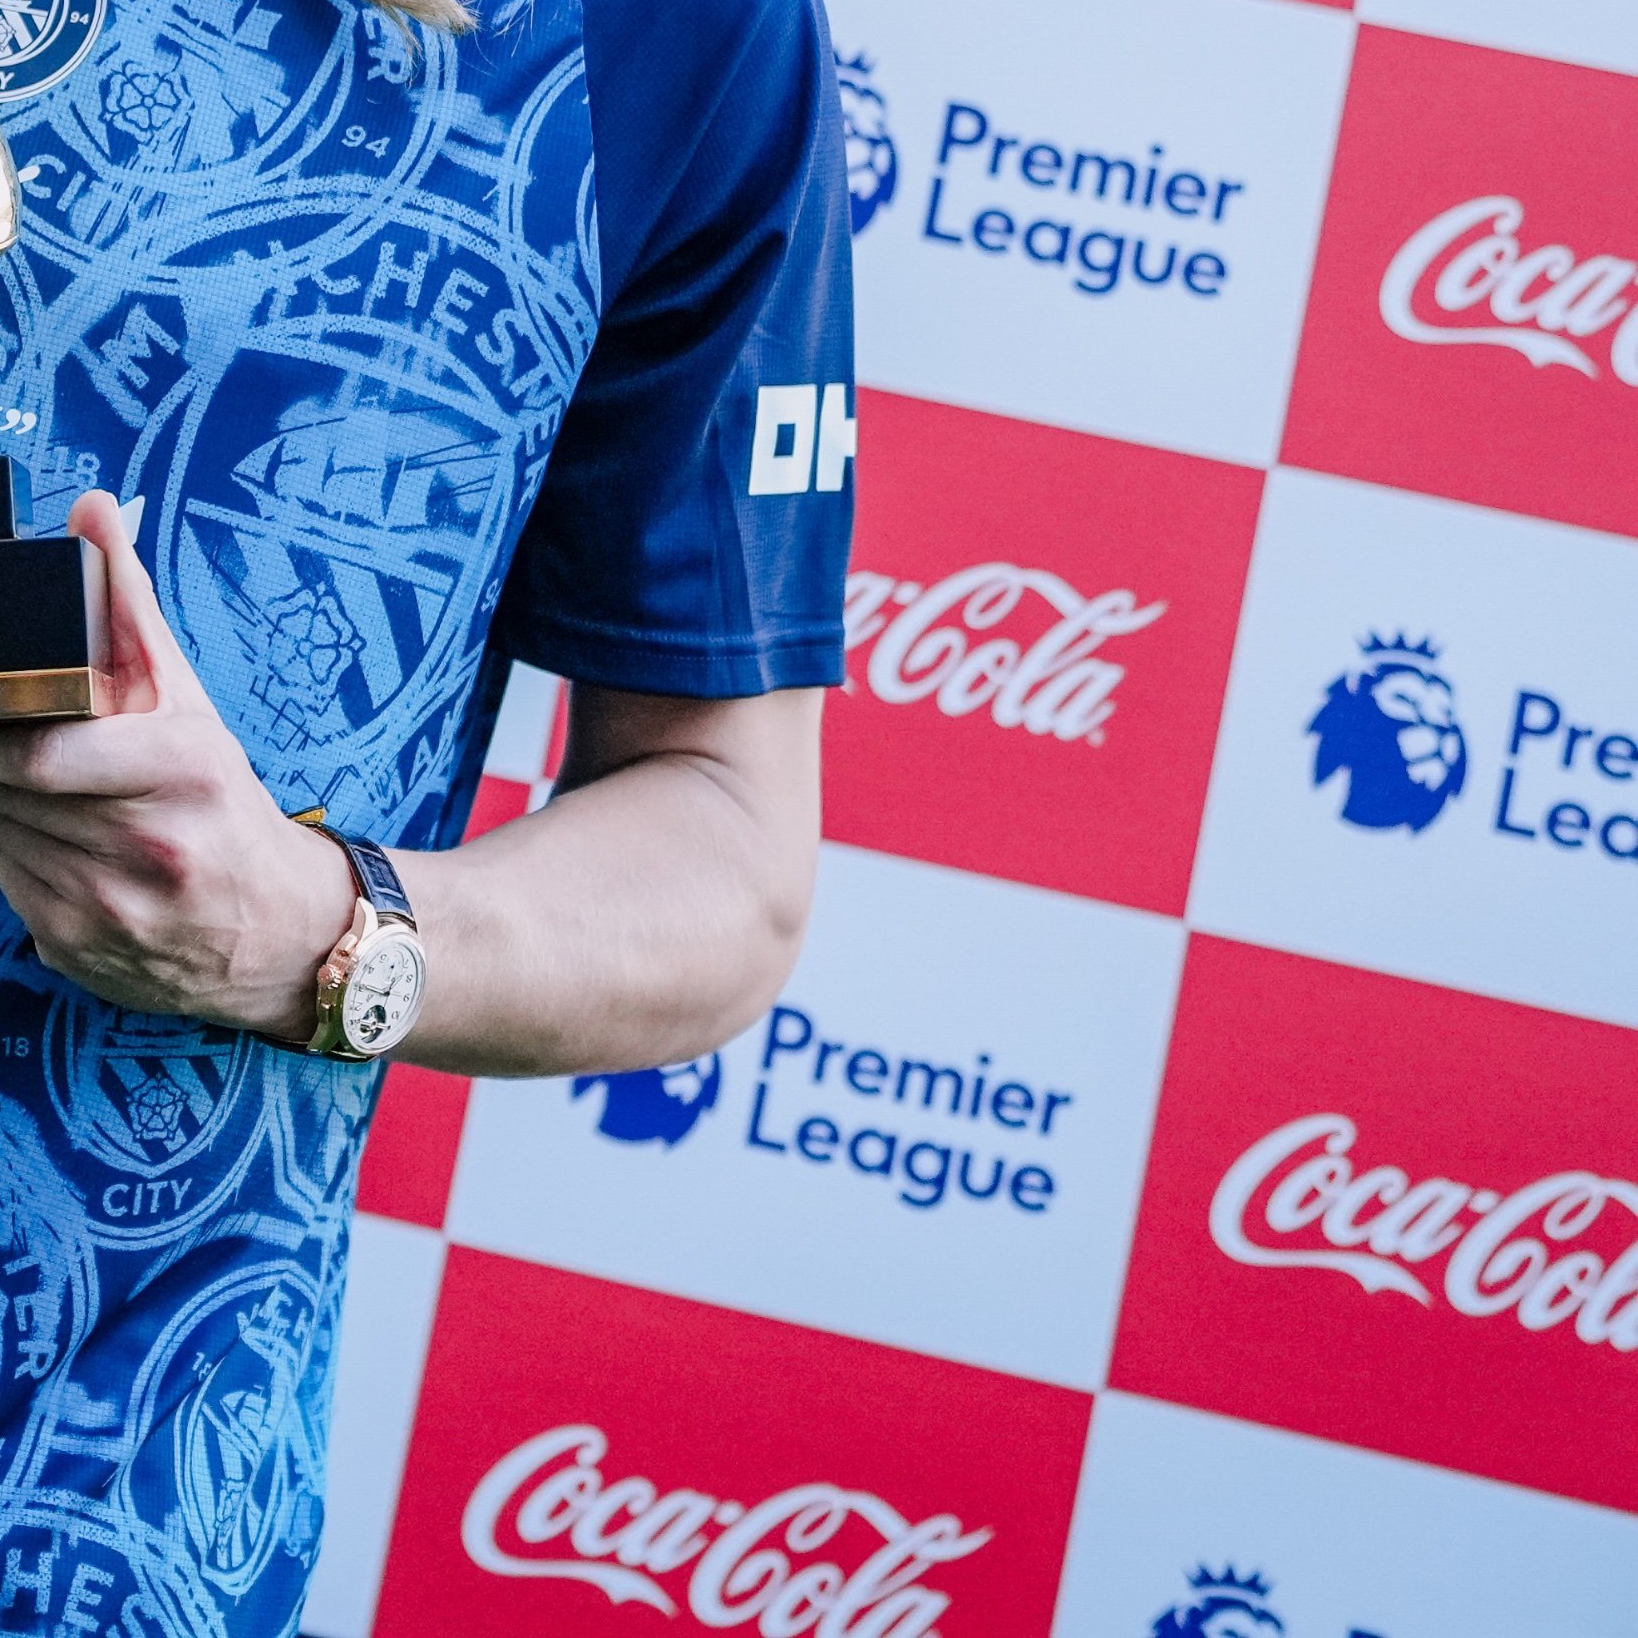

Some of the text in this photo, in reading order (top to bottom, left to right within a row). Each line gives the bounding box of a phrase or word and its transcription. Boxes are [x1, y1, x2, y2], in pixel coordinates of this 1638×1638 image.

[69, 11, 89, 26] 94
[341, 124, 391, 160] 94
[937, 102, 1244, 222] Premier
[922, 176, 1227, 296] League
[1495, 767, 1638, 861] Lea
[1, 1036, 30, 1058] 18
[762, 1006, 1072, 1135] Premier
[747, 1082, 1055, 1213] League
[102, 1177, 193, 1218] CITY
